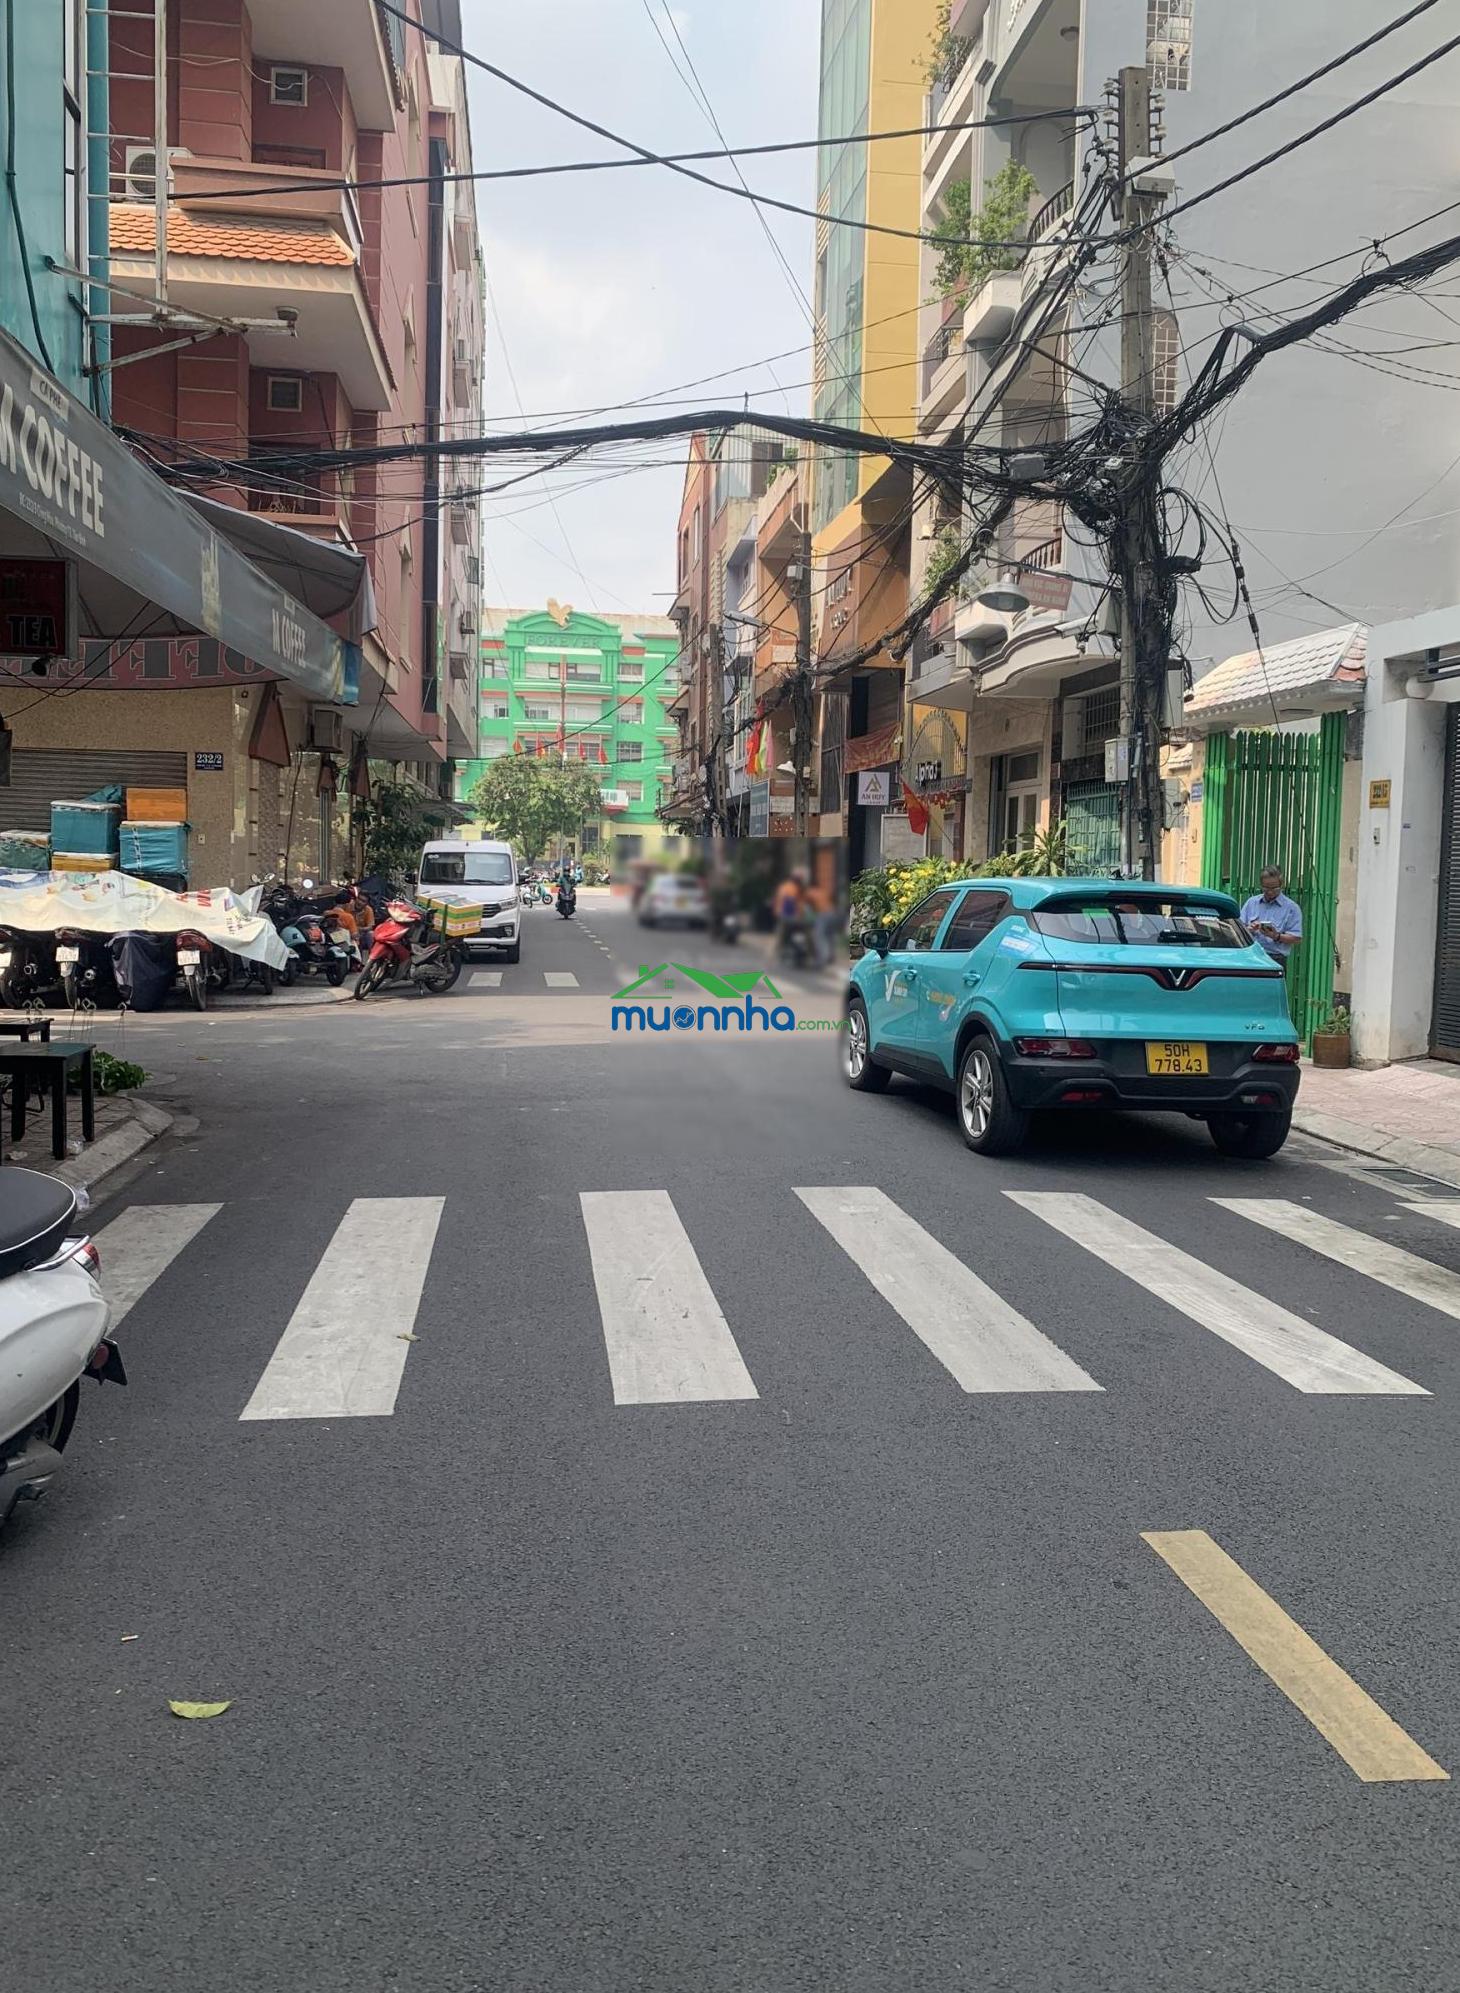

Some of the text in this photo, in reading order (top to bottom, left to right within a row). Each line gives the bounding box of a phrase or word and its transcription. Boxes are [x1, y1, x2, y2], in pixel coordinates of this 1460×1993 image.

[20, 404, 104, 538] COFFEE
[6, 614, 58, 649] TEA
[196, 753, 222, 764] 232/2
[1164, 1044, 1190, 1058] 50H
[1155, 1058, 1203, 1072] 778.43
